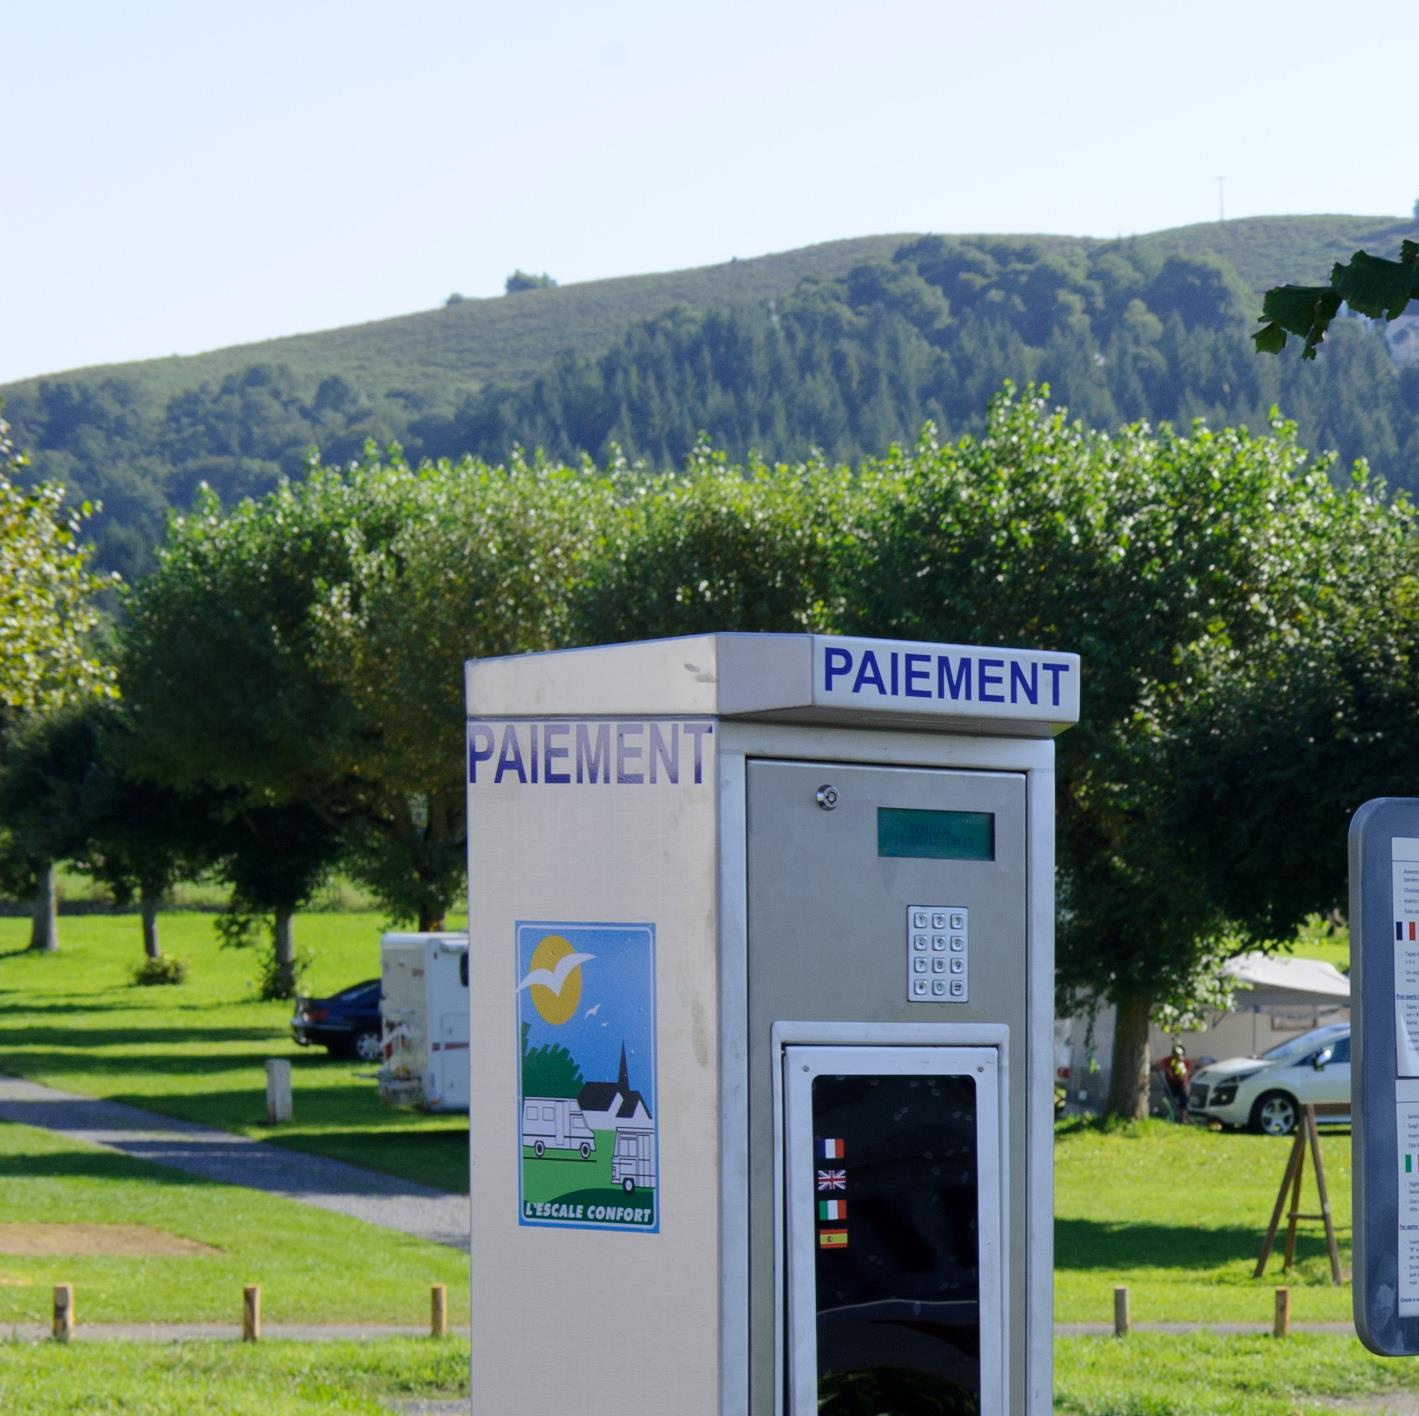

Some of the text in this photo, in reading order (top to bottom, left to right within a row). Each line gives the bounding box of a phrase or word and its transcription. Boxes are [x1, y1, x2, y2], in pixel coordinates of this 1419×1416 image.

[824, 646, 1070, 707] PAIEMENT
[468, 723, 713, 784] PAIEMENT
[525, 1202, 651, 1222] L'ESCALE CONFORT
